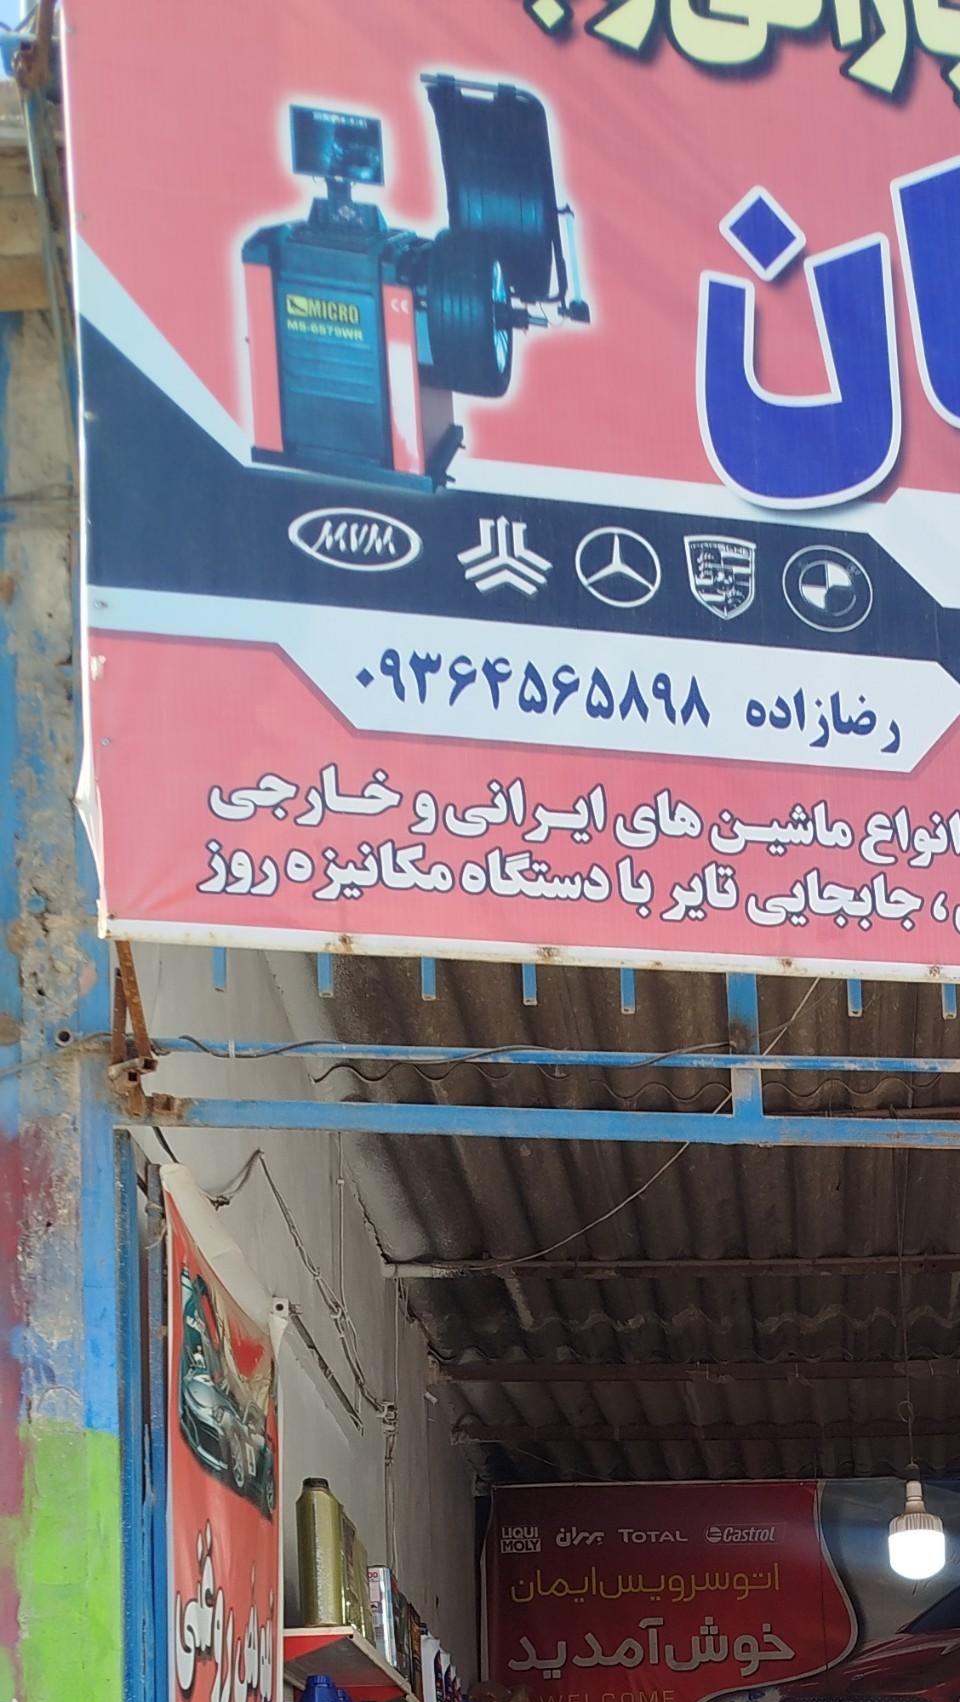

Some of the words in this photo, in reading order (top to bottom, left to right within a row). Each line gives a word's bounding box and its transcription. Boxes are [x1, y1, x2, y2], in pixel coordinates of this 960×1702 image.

[306, 300, 360, 325] MICRO
[314, 519, 395, 556] MVM
[356, 646, 711, 728] ۰۹۳۶۴۵۶۵۸۹۸
[744, 686, 902, 754] رضازاده
[207, 762, 404, 827] خارجی
[411, 790, 438, 836] و
[443, 779, 607, 845] ایرانی
[614, 788, 704, 849] های
[709, 800, 854, 856] ماشین
[197, 838, 279, 896] روز
[285, 840, 449, 904] مکانیزه
[458, 846, 612, 902] دستگاه
[615, 855, 655, 905] با
[663, 860, 740, 921] تایر
[746, 867, 923, 931] جابجایی
[501, 1526, 539, 1540] LIQUI
[501, 1538, 541, 1553] MOLY
[617, 1528, 689, 1544] TOTAL
[722, 1525, 776, 1543] Castrol
[510, 1566, 599, 1604] ایمان
[599, 1562, 781, 1602] اتوسرویس
[507, 1616, 665, 1680] آمدید
[664, 1615, 796, 1678] خوش
